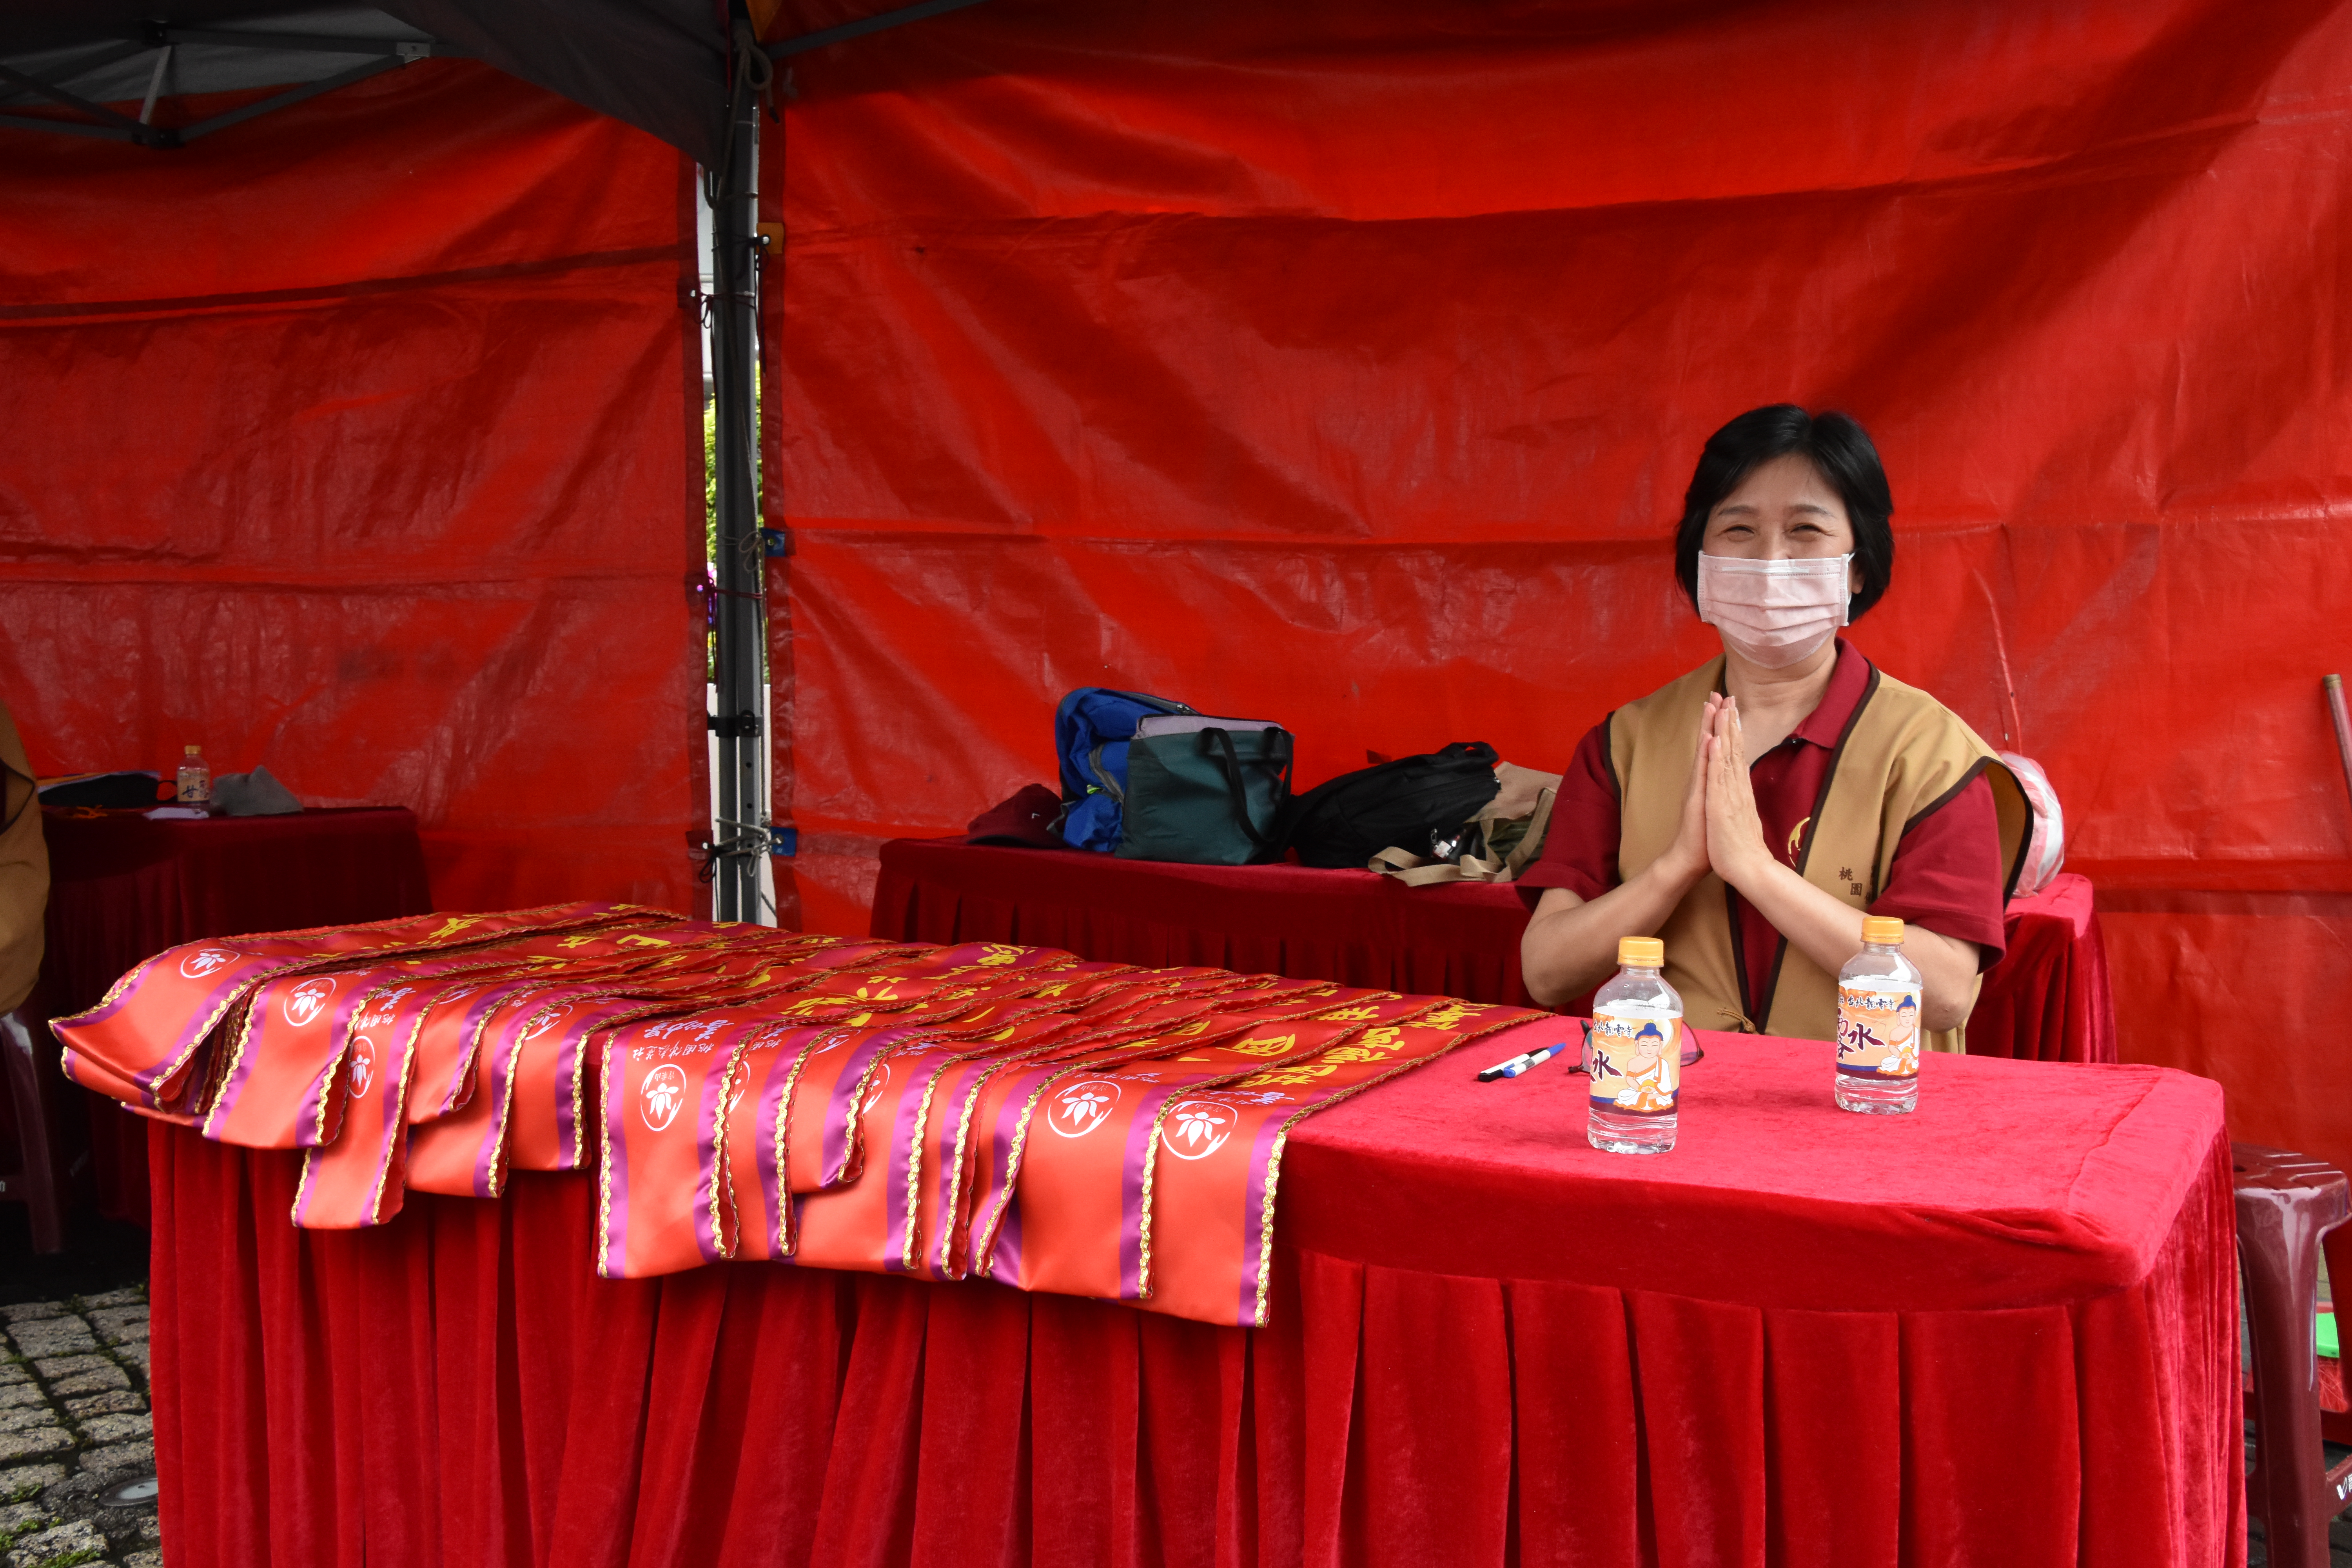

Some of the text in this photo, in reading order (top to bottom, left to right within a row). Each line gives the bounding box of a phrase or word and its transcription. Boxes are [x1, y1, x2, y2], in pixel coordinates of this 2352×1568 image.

[633, 1040, 715, 1061] 桃園佛教蓮社
